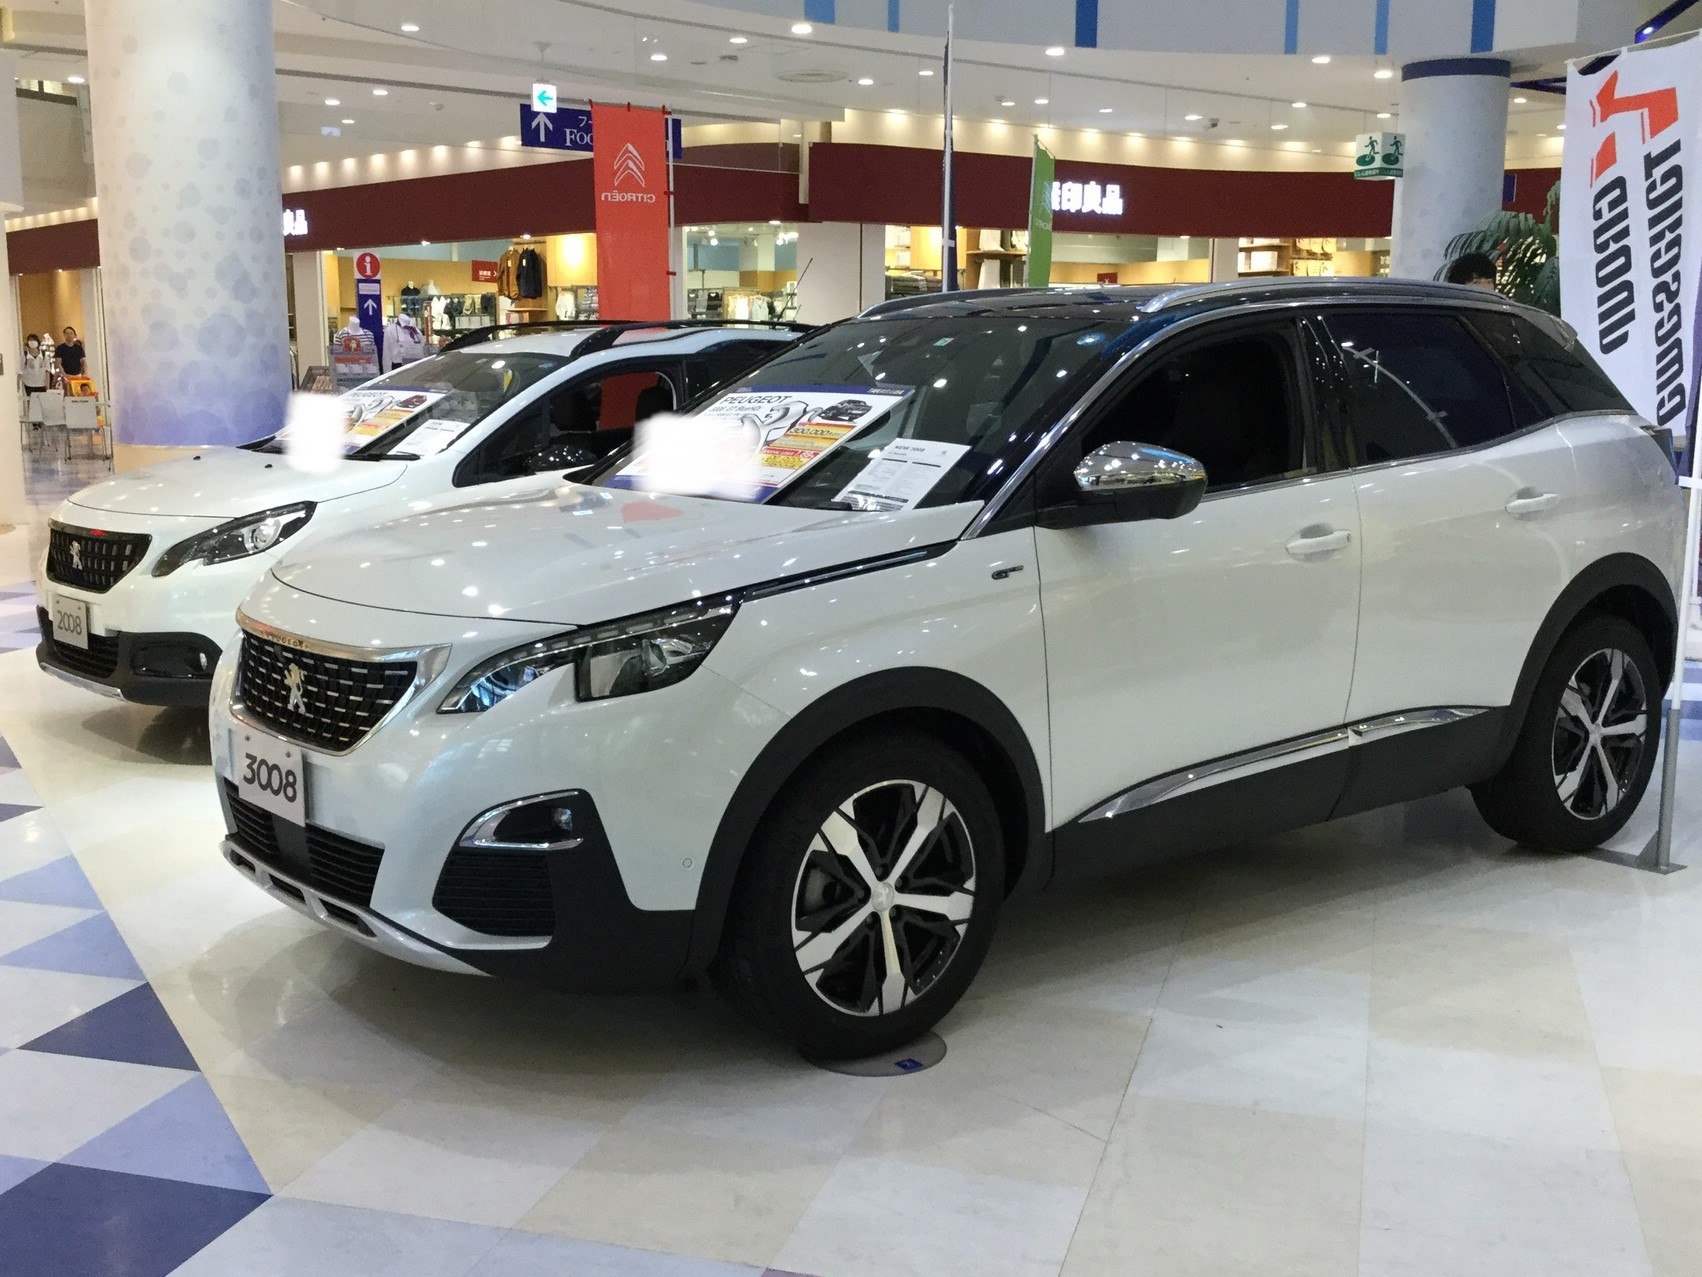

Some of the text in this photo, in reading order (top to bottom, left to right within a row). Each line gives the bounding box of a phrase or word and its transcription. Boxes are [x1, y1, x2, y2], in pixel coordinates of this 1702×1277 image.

[720, 395, 792, 404] PEUGEOT
[57, 610, 82, 635] 2008
[243, 752, 297, 803] 3008
